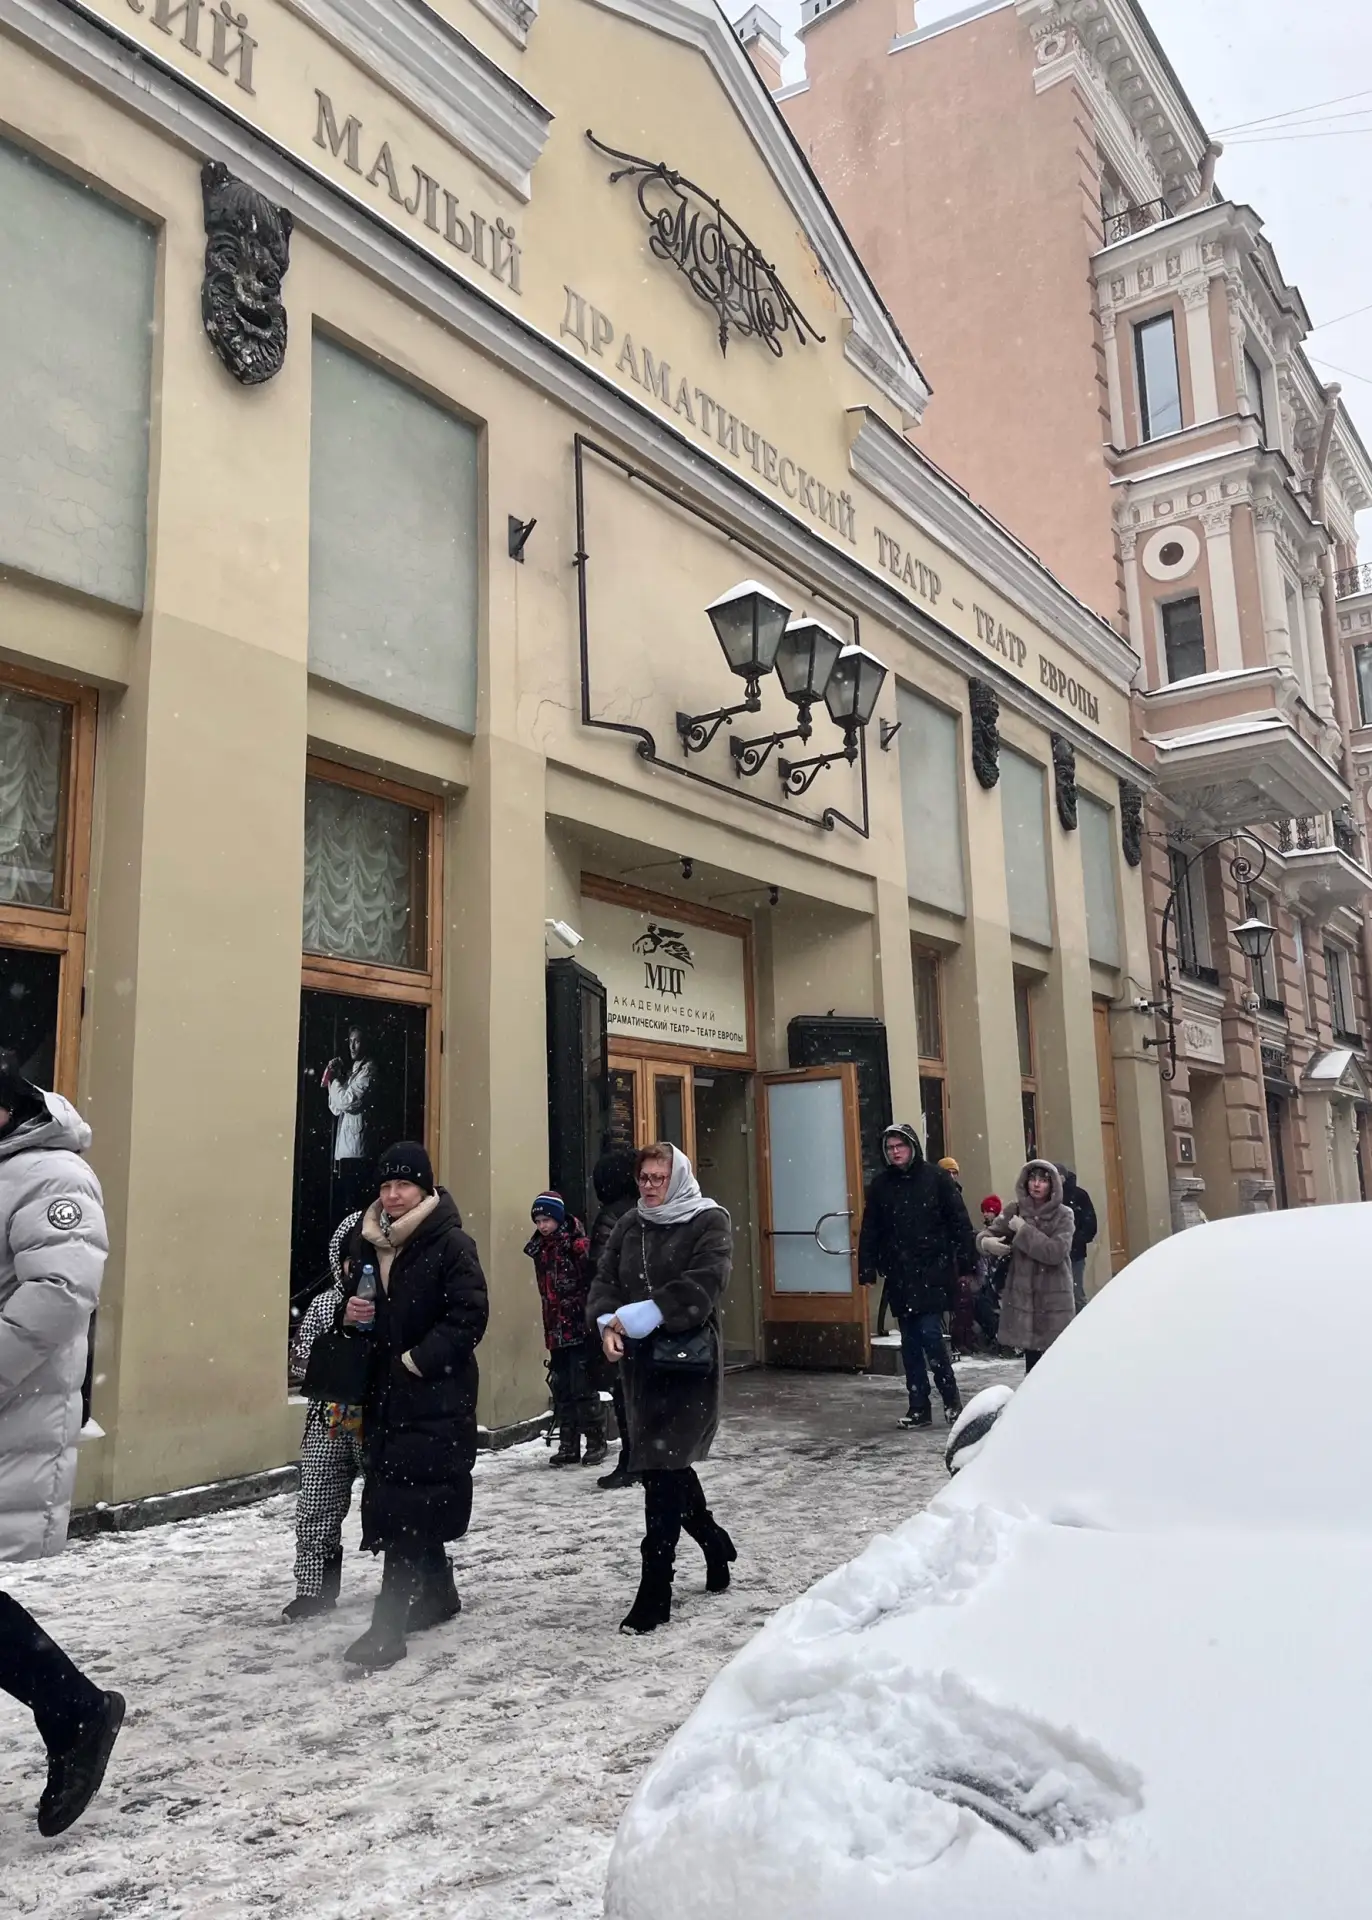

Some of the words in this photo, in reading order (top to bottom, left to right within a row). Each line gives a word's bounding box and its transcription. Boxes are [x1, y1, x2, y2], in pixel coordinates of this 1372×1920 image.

[127, 0, 258, 96] ИЙ
[313, 88, 522, 296] МАЛЫЙ
[560, 284, 857, 545] ДРАМАТИЧЕСКИЙ
[874, 526, 942, 605] ТЕАТР
[973, 603, 1027, 668] ТЕАТР
[1038, 654, 1100, 725] ЕВРОПЫ
[643, 961, 686, 1000] МДТ
[613, 995, 716, 1022] АКАДЕМИЧЕСКИЙ
[607, 1012, 668, 1032] ДРАМАТИЧЕСКИЙ
[669, 1022, 690, 1034] ТЕАТР
[696, 1026, 716, 1038] ТЕАТР
[717, 1030, 744, 1043] ЕВРОПЫ
